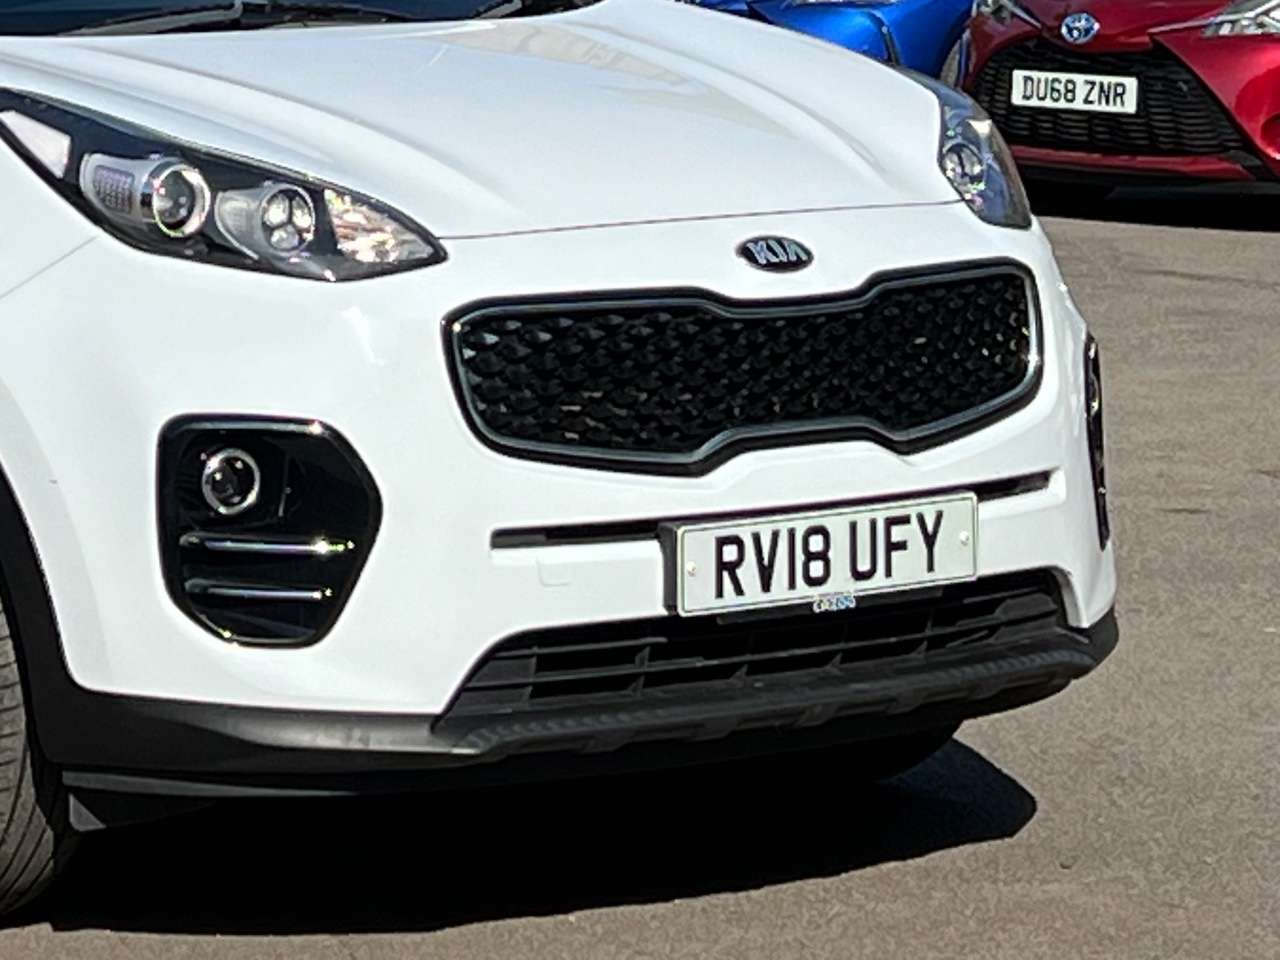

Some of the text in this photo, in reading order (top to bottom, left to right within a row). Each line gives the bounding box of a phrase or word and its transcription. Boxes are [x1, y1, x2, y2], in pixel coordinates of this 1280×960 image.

[1022, 75, 1127, 107] DU68 ZNR
[746, 239, 809, 264] KIA
[714, 509, 944, 599] RV18 UFY
